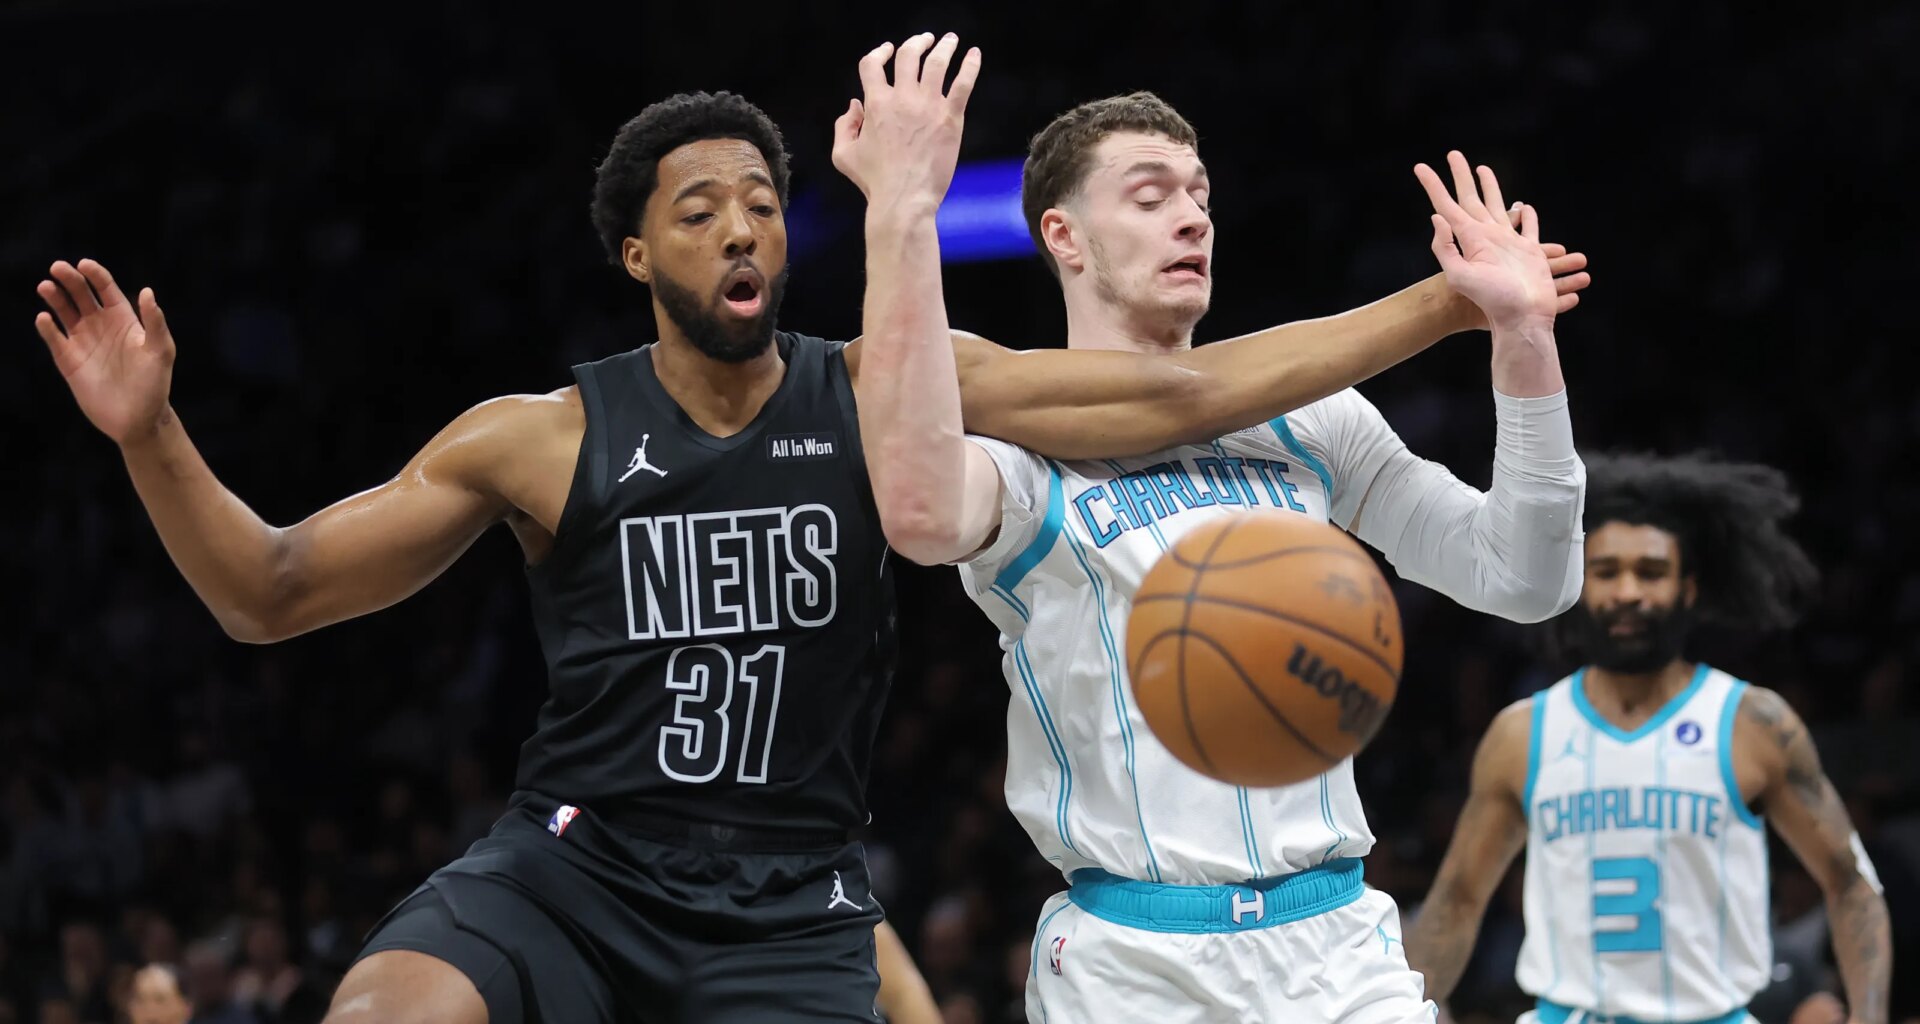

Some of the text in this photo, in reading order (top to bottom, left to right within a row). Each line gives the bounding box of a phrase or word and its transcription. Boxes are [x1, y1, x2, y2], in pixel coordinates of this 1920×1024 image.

[772, 438, 833, 458] All In Won
[1073, 457, 1306, 548] CHARLOTTE
[620, 503, 837, 640] NETS
[658, 643, 786, 784] 31
[1538, 786, 1722, 843] CHARLOTTE
[1592, 857, 1663, 953] 3
